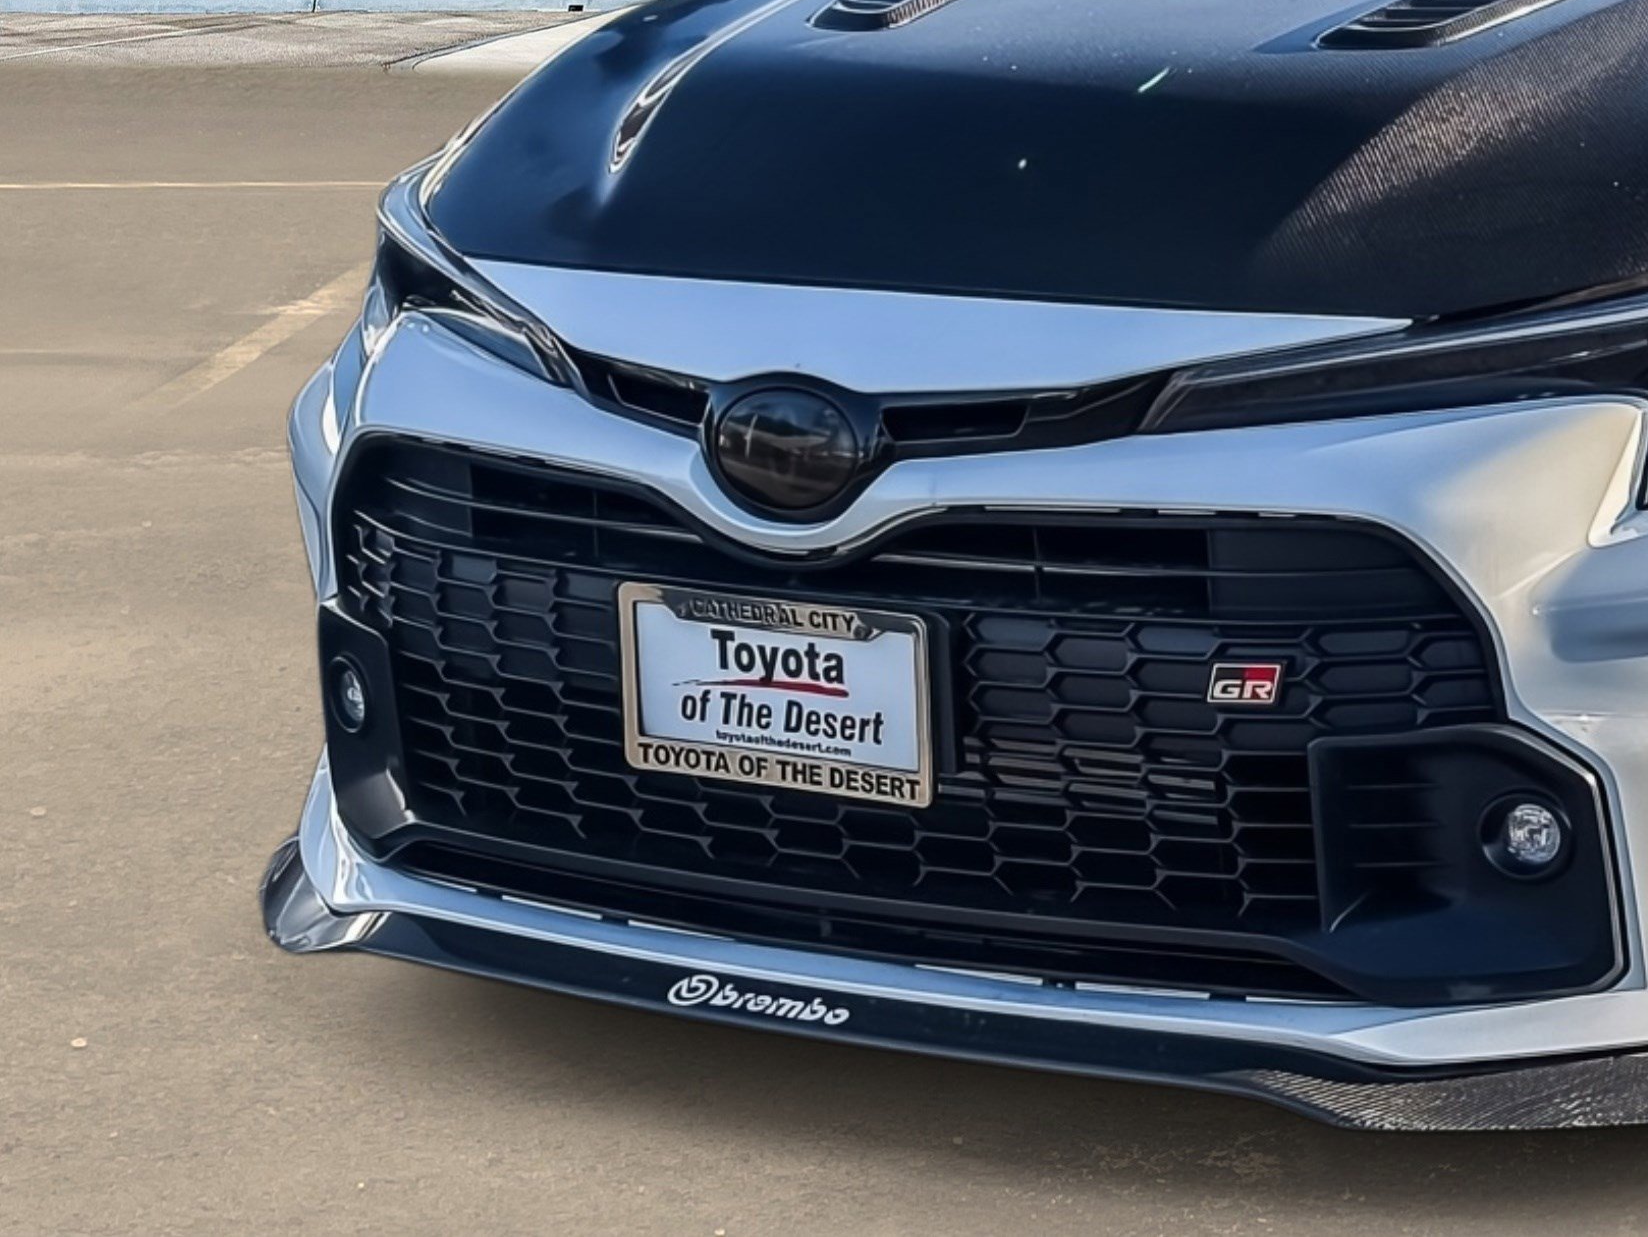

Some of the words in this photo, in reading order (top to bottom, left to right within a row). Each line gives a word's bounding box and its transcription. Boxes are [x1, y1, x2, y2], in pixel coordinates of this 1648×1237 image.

[690, 599, 804, 628] CATHEDRAL
[808, 610, 855, 633] CITY
[711, 628, 844, 685] Toyota
[1212, 679, 1273, 699] GR
[681, 689, 711, 723] of
[720, 692, 773, 730] The
[783, 700, 885, 745] Desert
[716, 730, 852, 757] toyotaofthedesert.com
[638, 742, 731, 774] TOYOTA
[738, 754, 769, 778] OF
[776, 760, 823, 786] THE
[829, 770, 921, 801] DESERT
